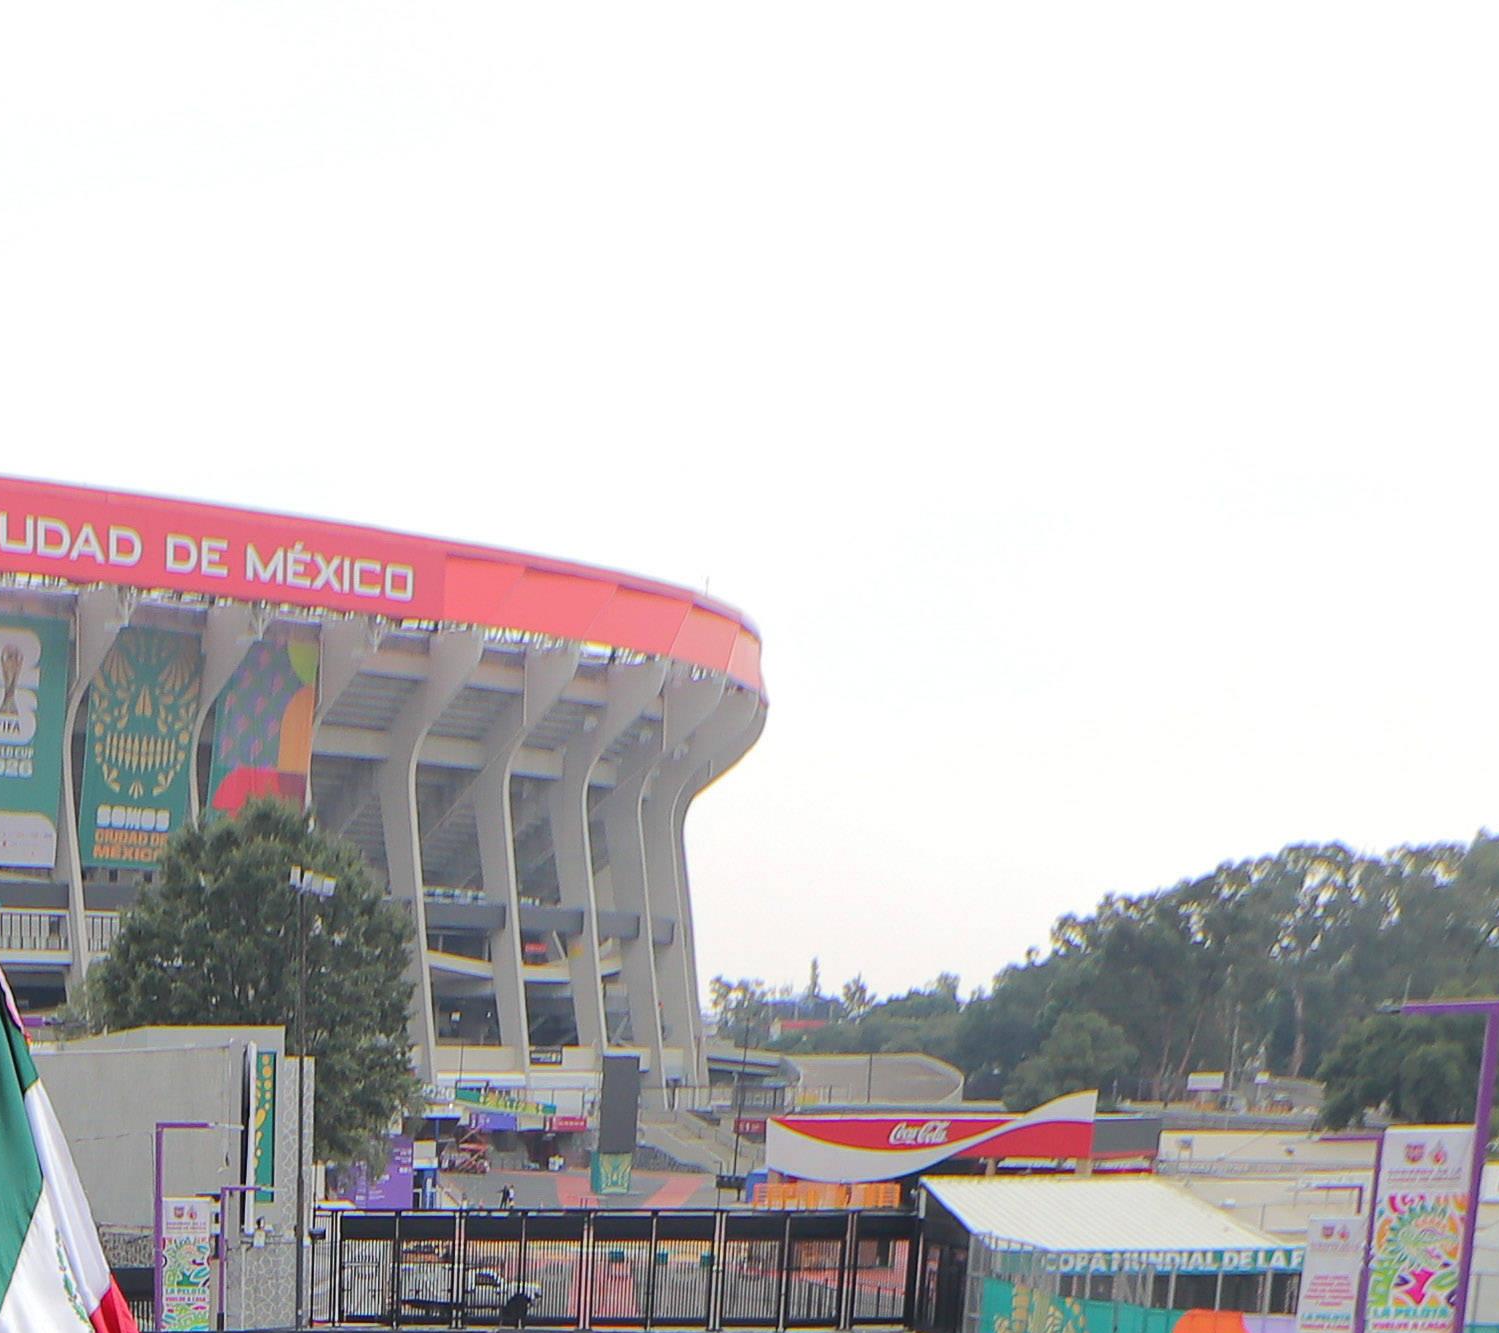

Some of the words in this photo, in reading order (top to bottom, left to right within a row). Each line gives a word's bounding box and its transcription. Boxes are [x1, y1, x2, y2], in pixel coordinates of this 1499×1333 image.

[165, 532, 229, 577] DE
[245, 541, 415, 602] MÉXICO
[14, 745, 34, 760] CUP
[96, 804, 170, 832] SOMOS
[95, 828, 149, 846] CIUDAD
[888, 1120, 950, 1146] Coca-Cola
[1042, 1250, 1107, 1273] COPA
[1111, 1249, 1218, 1272] MUNDIAL
[1222, 1249, 1253, 1269] DE
[1256, 1248, 1289, 1269] LA
